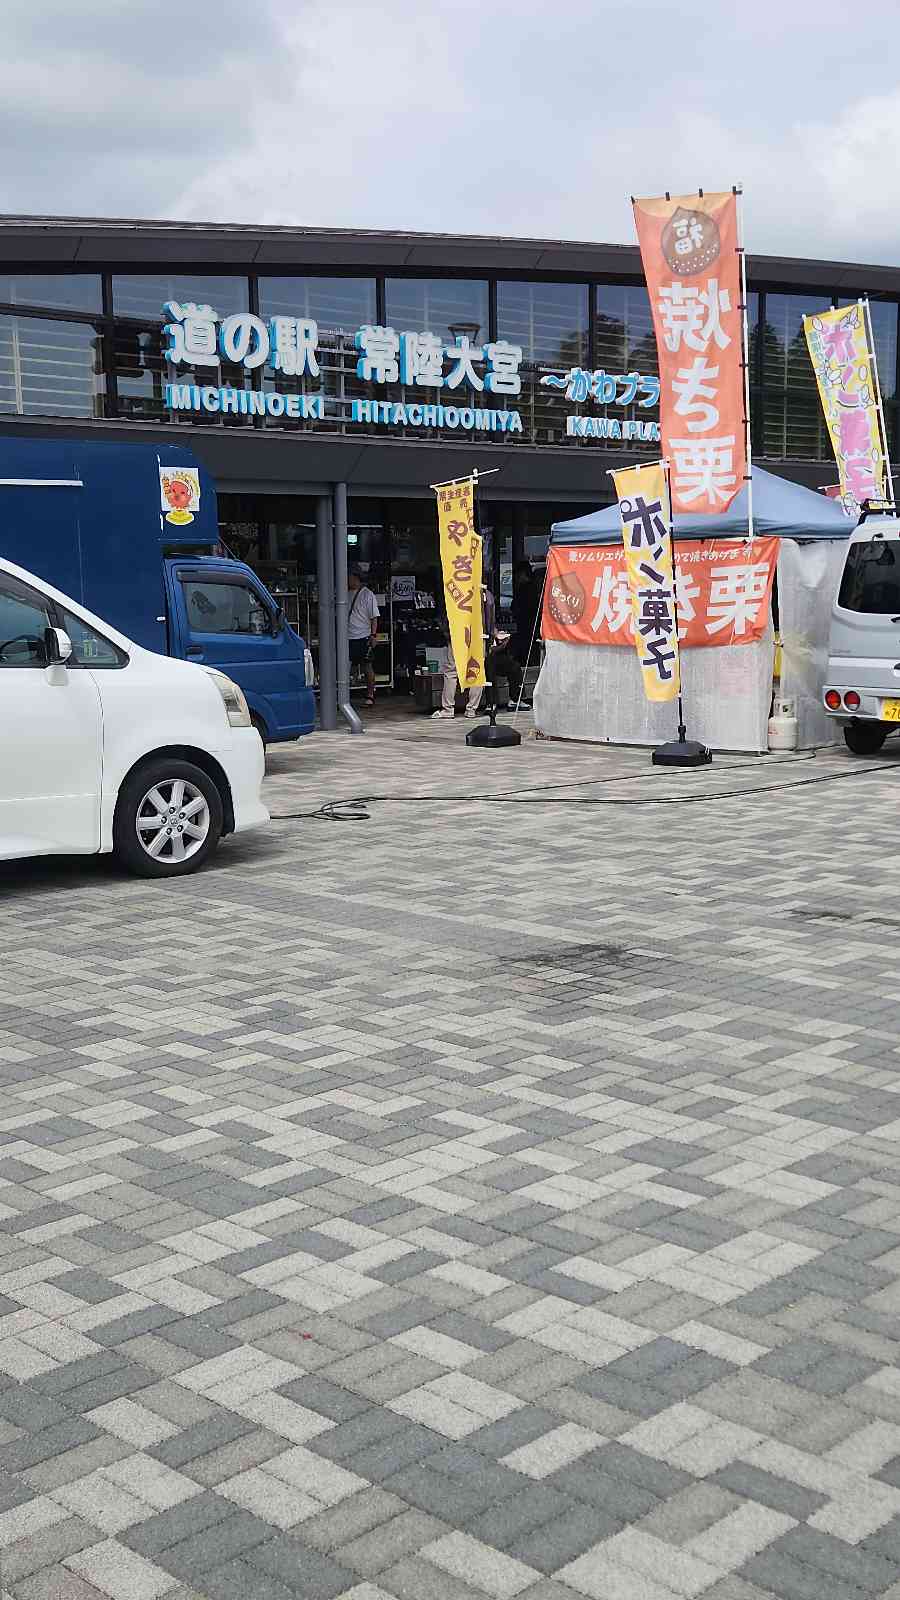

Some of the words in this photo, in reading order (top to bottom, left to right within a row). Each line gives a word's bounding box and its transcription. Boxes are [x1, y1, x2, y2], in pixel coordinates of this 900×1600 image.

[162, 300, 321, 378] 道の駅
[354, 324, 523, 395] 常陸大宮
[165, 383, 325, 419] MICHINOEKI
[351, 399, 524, 432] HITACHIOOMIYA
[566, 415, 622, 439] KAWA
